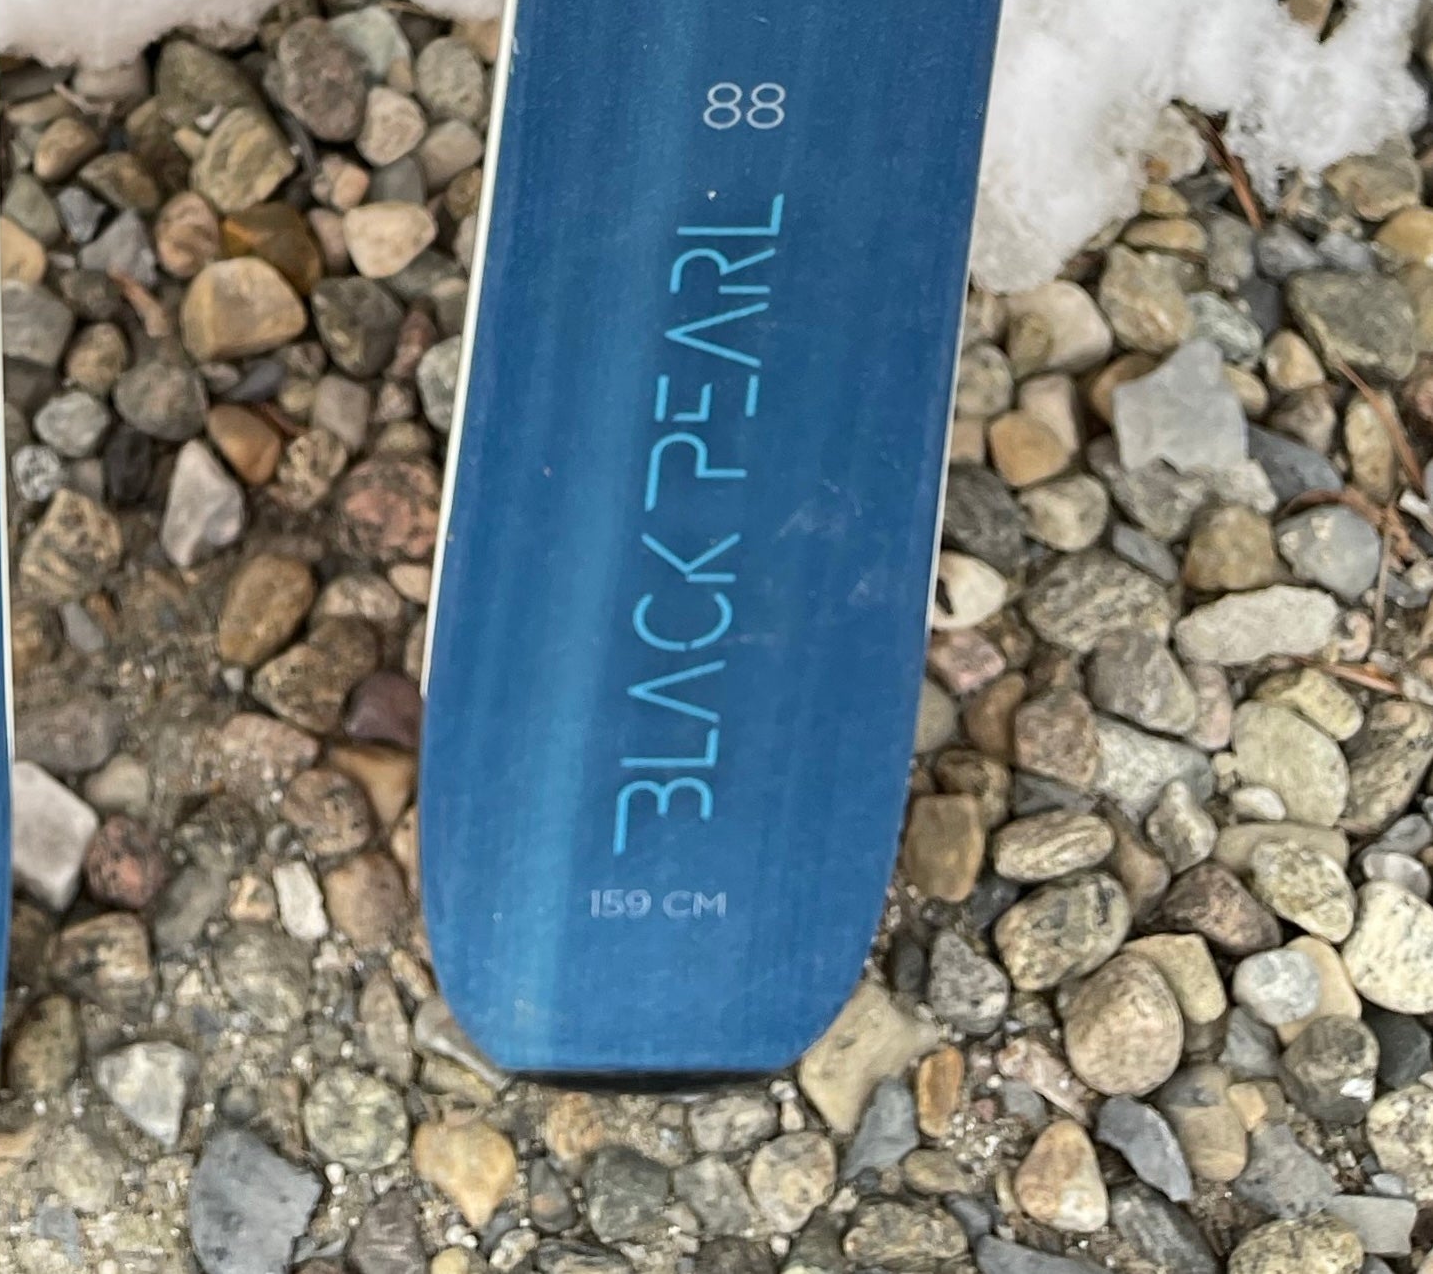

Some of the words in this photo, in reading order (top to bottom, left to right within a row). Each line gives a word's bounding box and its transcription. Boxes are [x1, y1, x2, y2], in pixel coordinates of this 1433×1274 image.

[702, 82, 786, 130] 88
[643, 194, 785, 511] PEARL
[613, 531, 742, 855] BLACK
[590, 889, 653, 920] 159
[662, 890, 728, 920] CM
